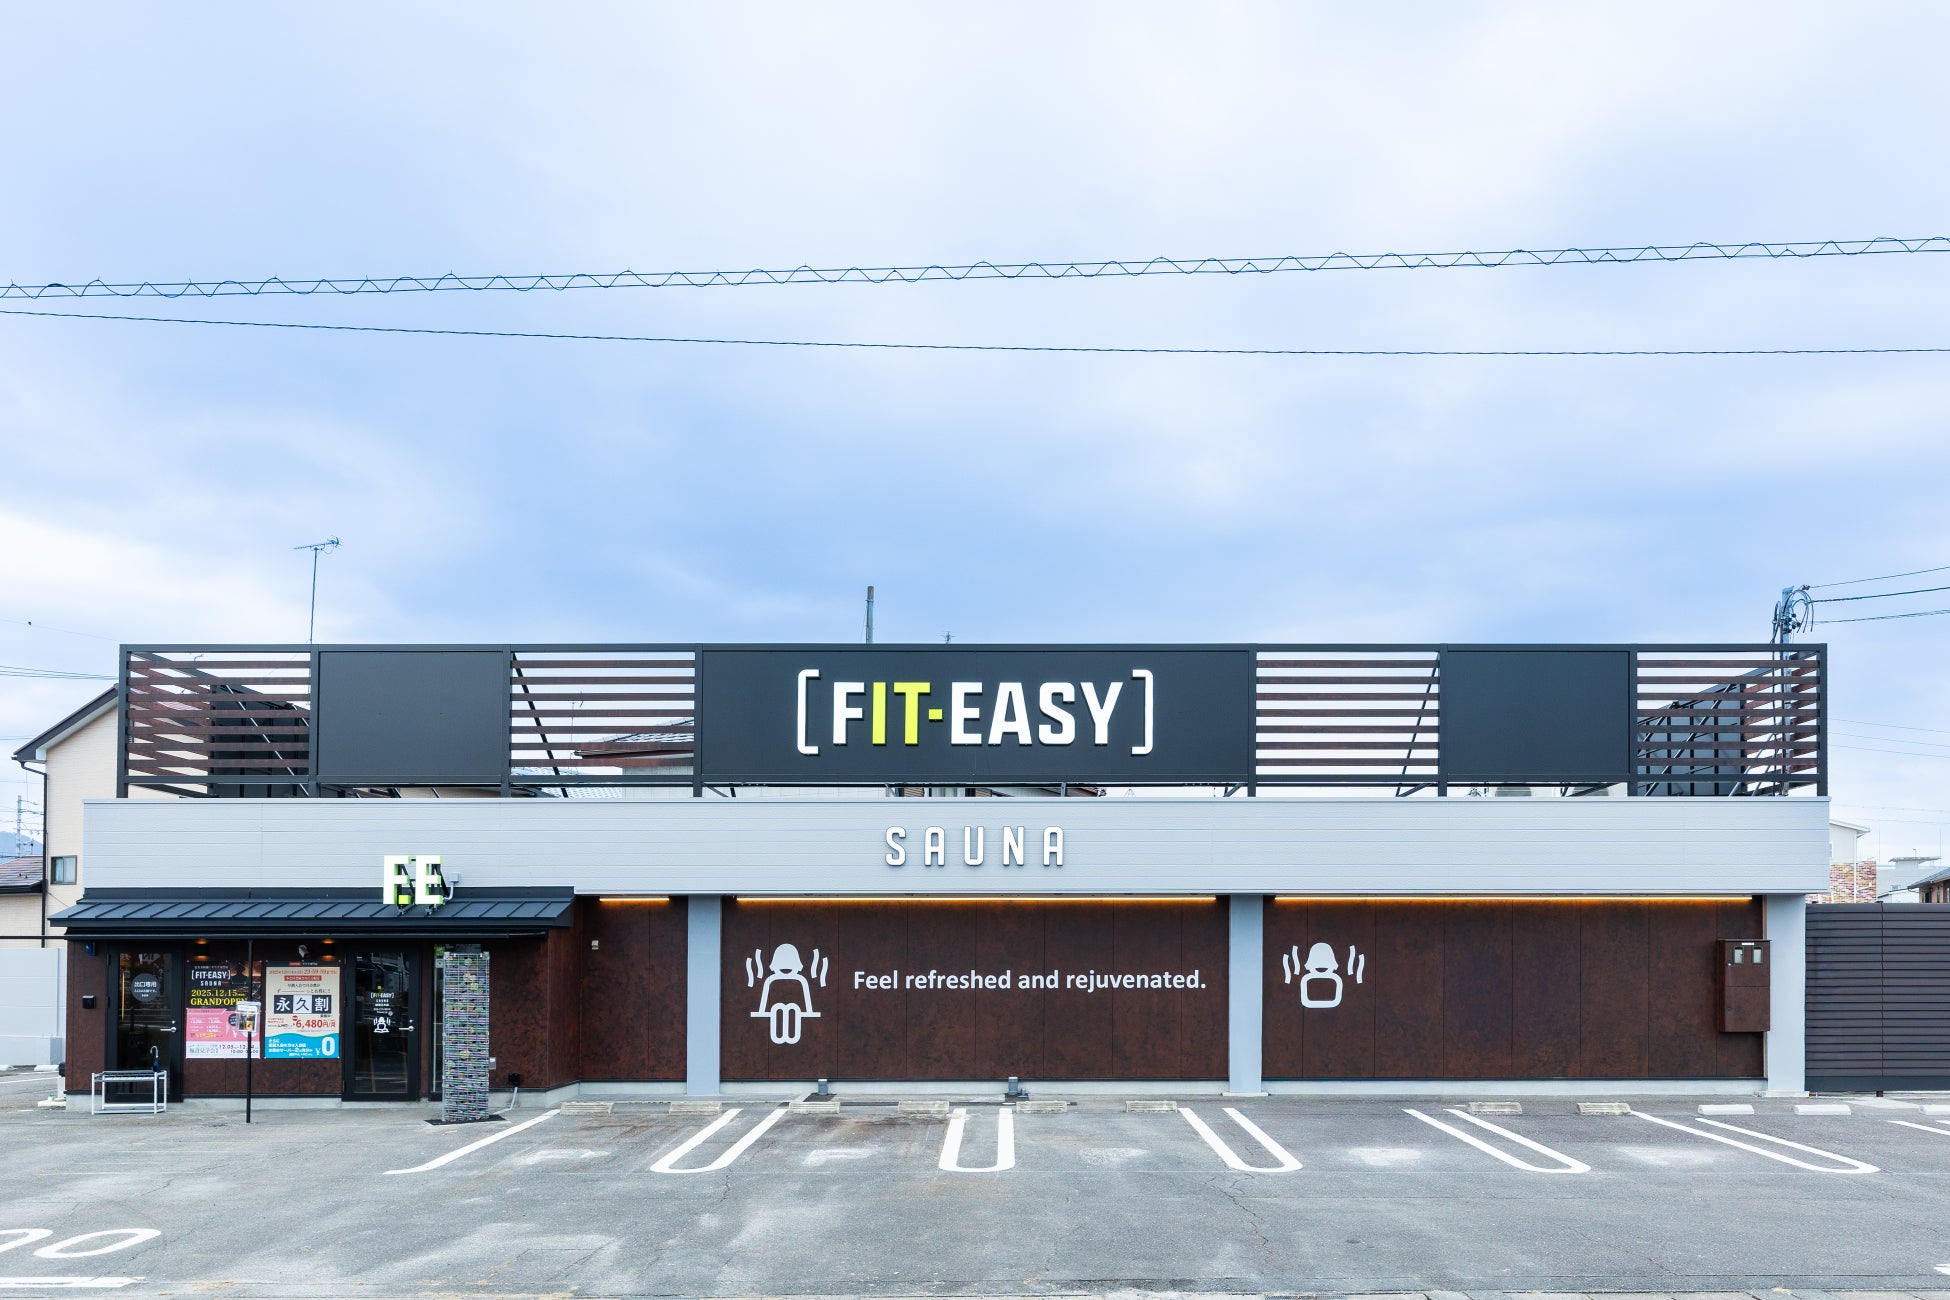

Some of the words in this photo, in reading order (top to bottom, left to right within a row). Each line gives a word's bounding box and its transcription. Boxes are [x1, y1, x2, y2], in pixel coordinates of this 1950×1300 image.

[885, 826, 1063, 866] SAUNA
[854, 969, 898, 989] Feel
[905, 969, 1011, 990] refreshed
[1018, 969, 1059, 989] and
[1066, 969, 1207, 993] rejuvenated.
[191, 989, 238, 998] 2025.12.15
[190, 998, 222, 1006] GRAND
[276, 997, 329, 1012] 永久割
